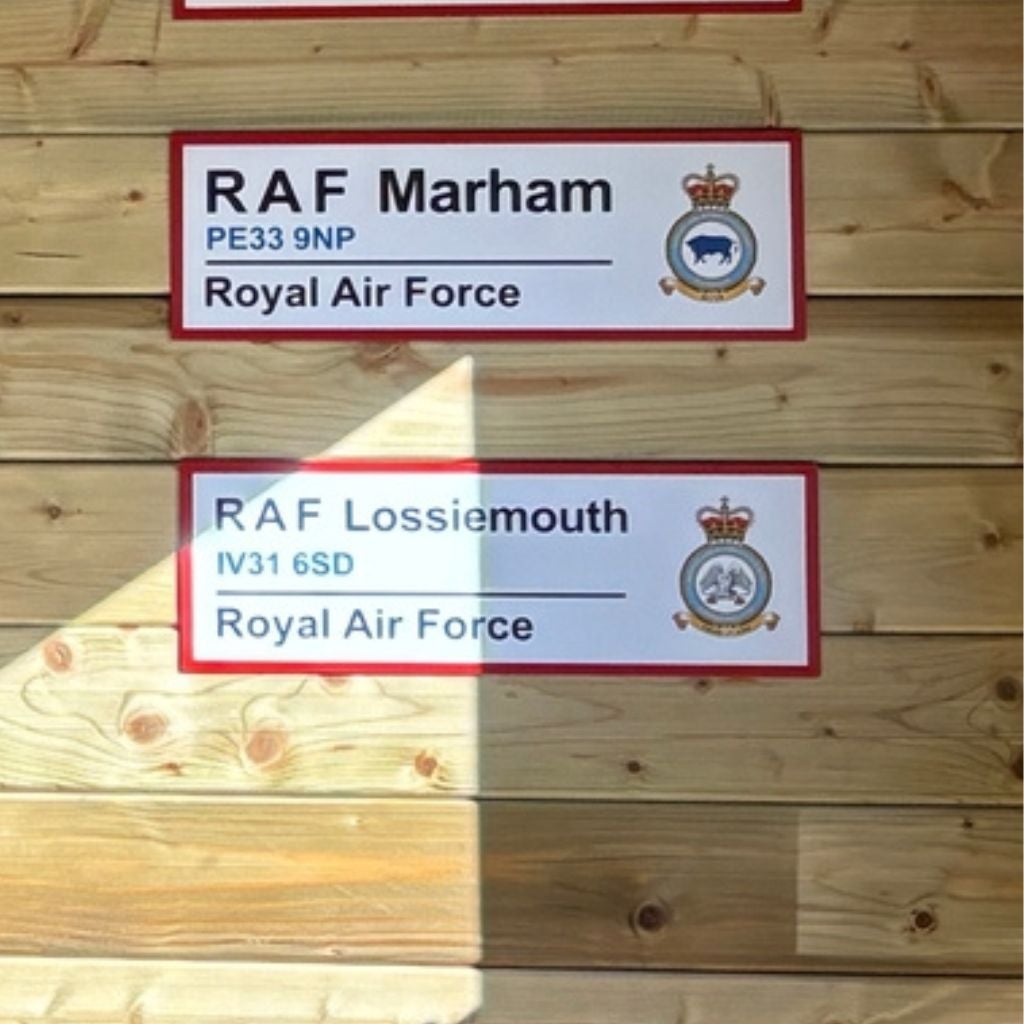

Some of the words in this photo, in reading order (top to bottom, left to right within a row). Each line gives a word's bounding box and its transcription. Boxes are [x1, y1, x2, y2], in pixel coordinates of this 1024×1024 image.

[206, 168, 349, 215] RAF
[379, 167, 613, 215] Marham
[206, 225, 284, 251] PE33
[293, 225, 357, 251] 9NP
[204, 275, 320, 317] Royal
[330, 275, 392, 309] Air
[404, 275, 522, 310] Force
[215, 497, 321, 532] RAF
[345, 497, 628, 535] Lossiemouth
[217, 551, 279, 576] IV31
[292, 551, 354, 577] 6SD
[216, 607, 330, 648] Royal
[343, 608, 403, 640] Air
[417, 608, 534, 643] Force
